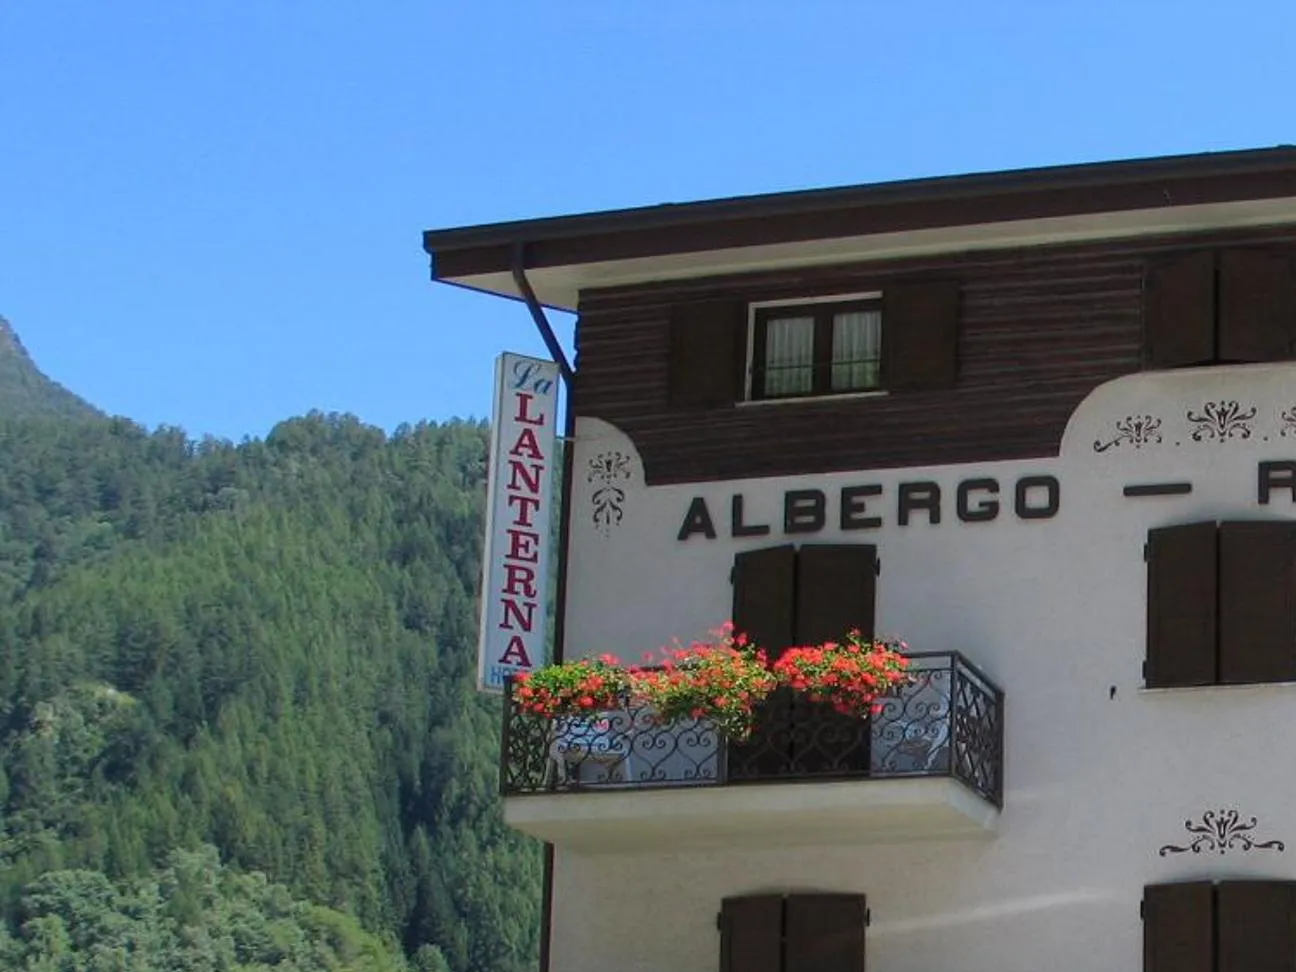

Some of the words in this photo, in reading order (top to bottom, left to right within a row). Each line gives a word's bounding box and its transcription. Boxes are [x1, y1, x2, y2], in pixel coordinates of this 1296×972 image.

[512, 360, 554, 396] La
[498, 392, 545, 667] LANTERNA
[677, 474, 1060, 541] ALBERGO
